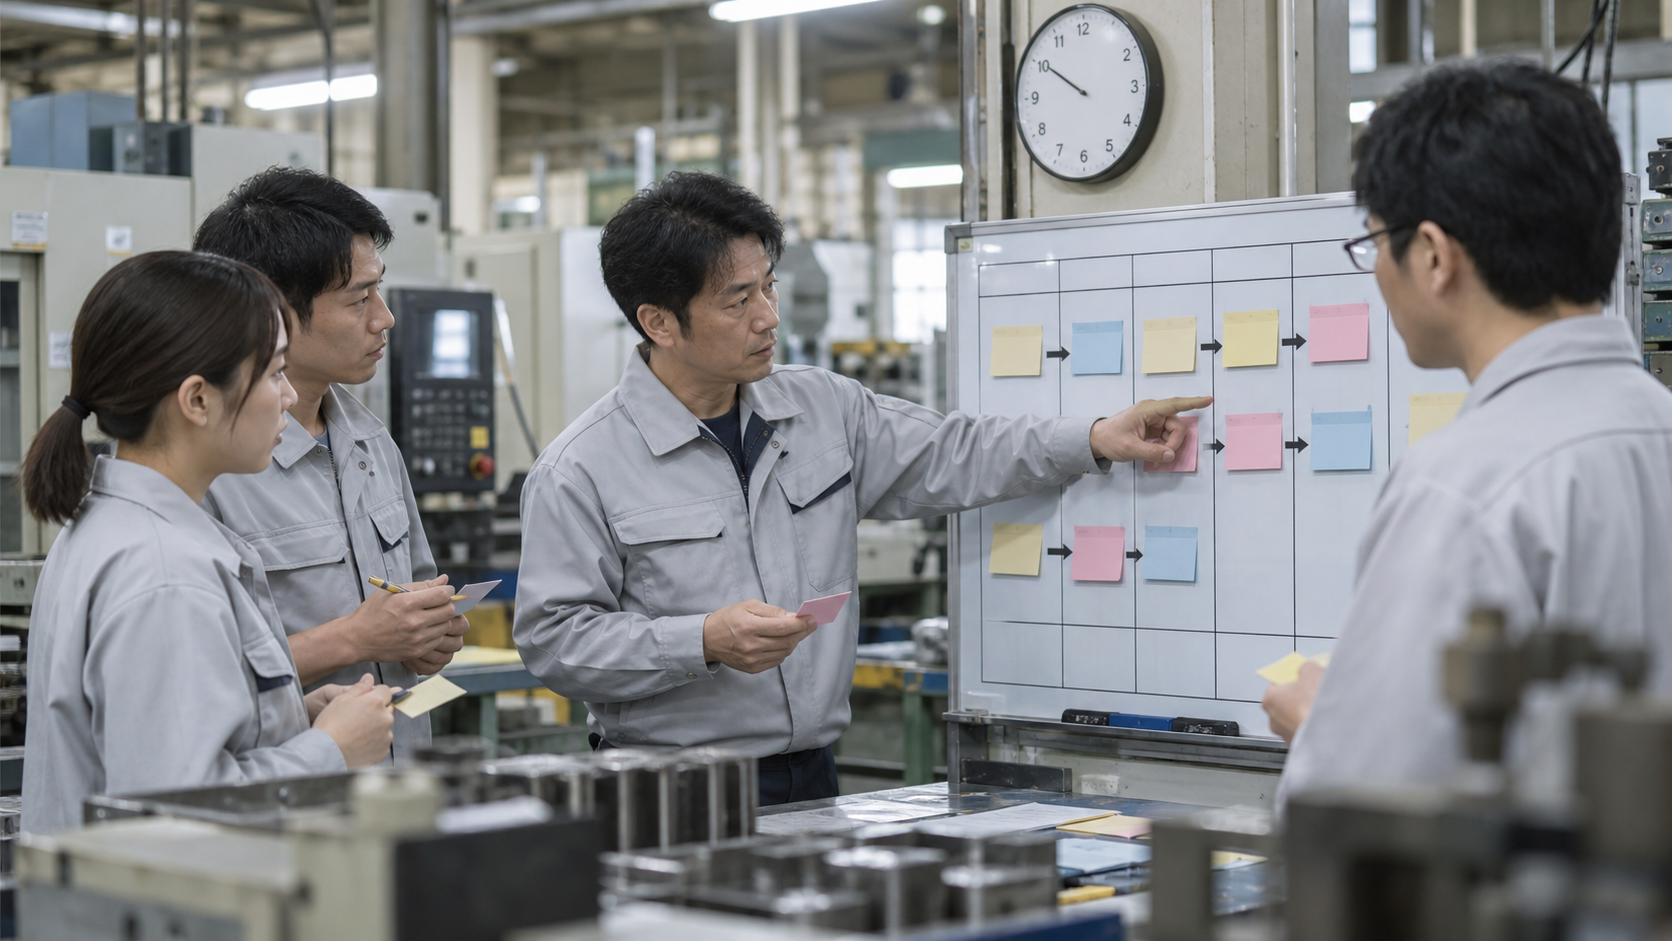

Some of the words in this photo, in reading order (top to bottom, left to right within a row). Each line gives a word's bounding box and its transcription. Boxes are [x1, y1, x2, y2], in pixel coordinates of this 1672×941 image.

[1077, 22, 1090, 36] 12
[1054, 35, 1064, 48] 11
[1123, 48, 1131, 62] 2
[1038, 60, 1050, 73] 10
[1130, 80, 1139, 94] 3
[1031, 91, 1040, 105] 9
[1123, 113, 1132, 127] 4
[1038, 122, 1046, 136] 8
[1056, 143, 1064, 157] 7
[1105, 139, 1114, 152] 5
[1080, 150, 1088, 163] 6
